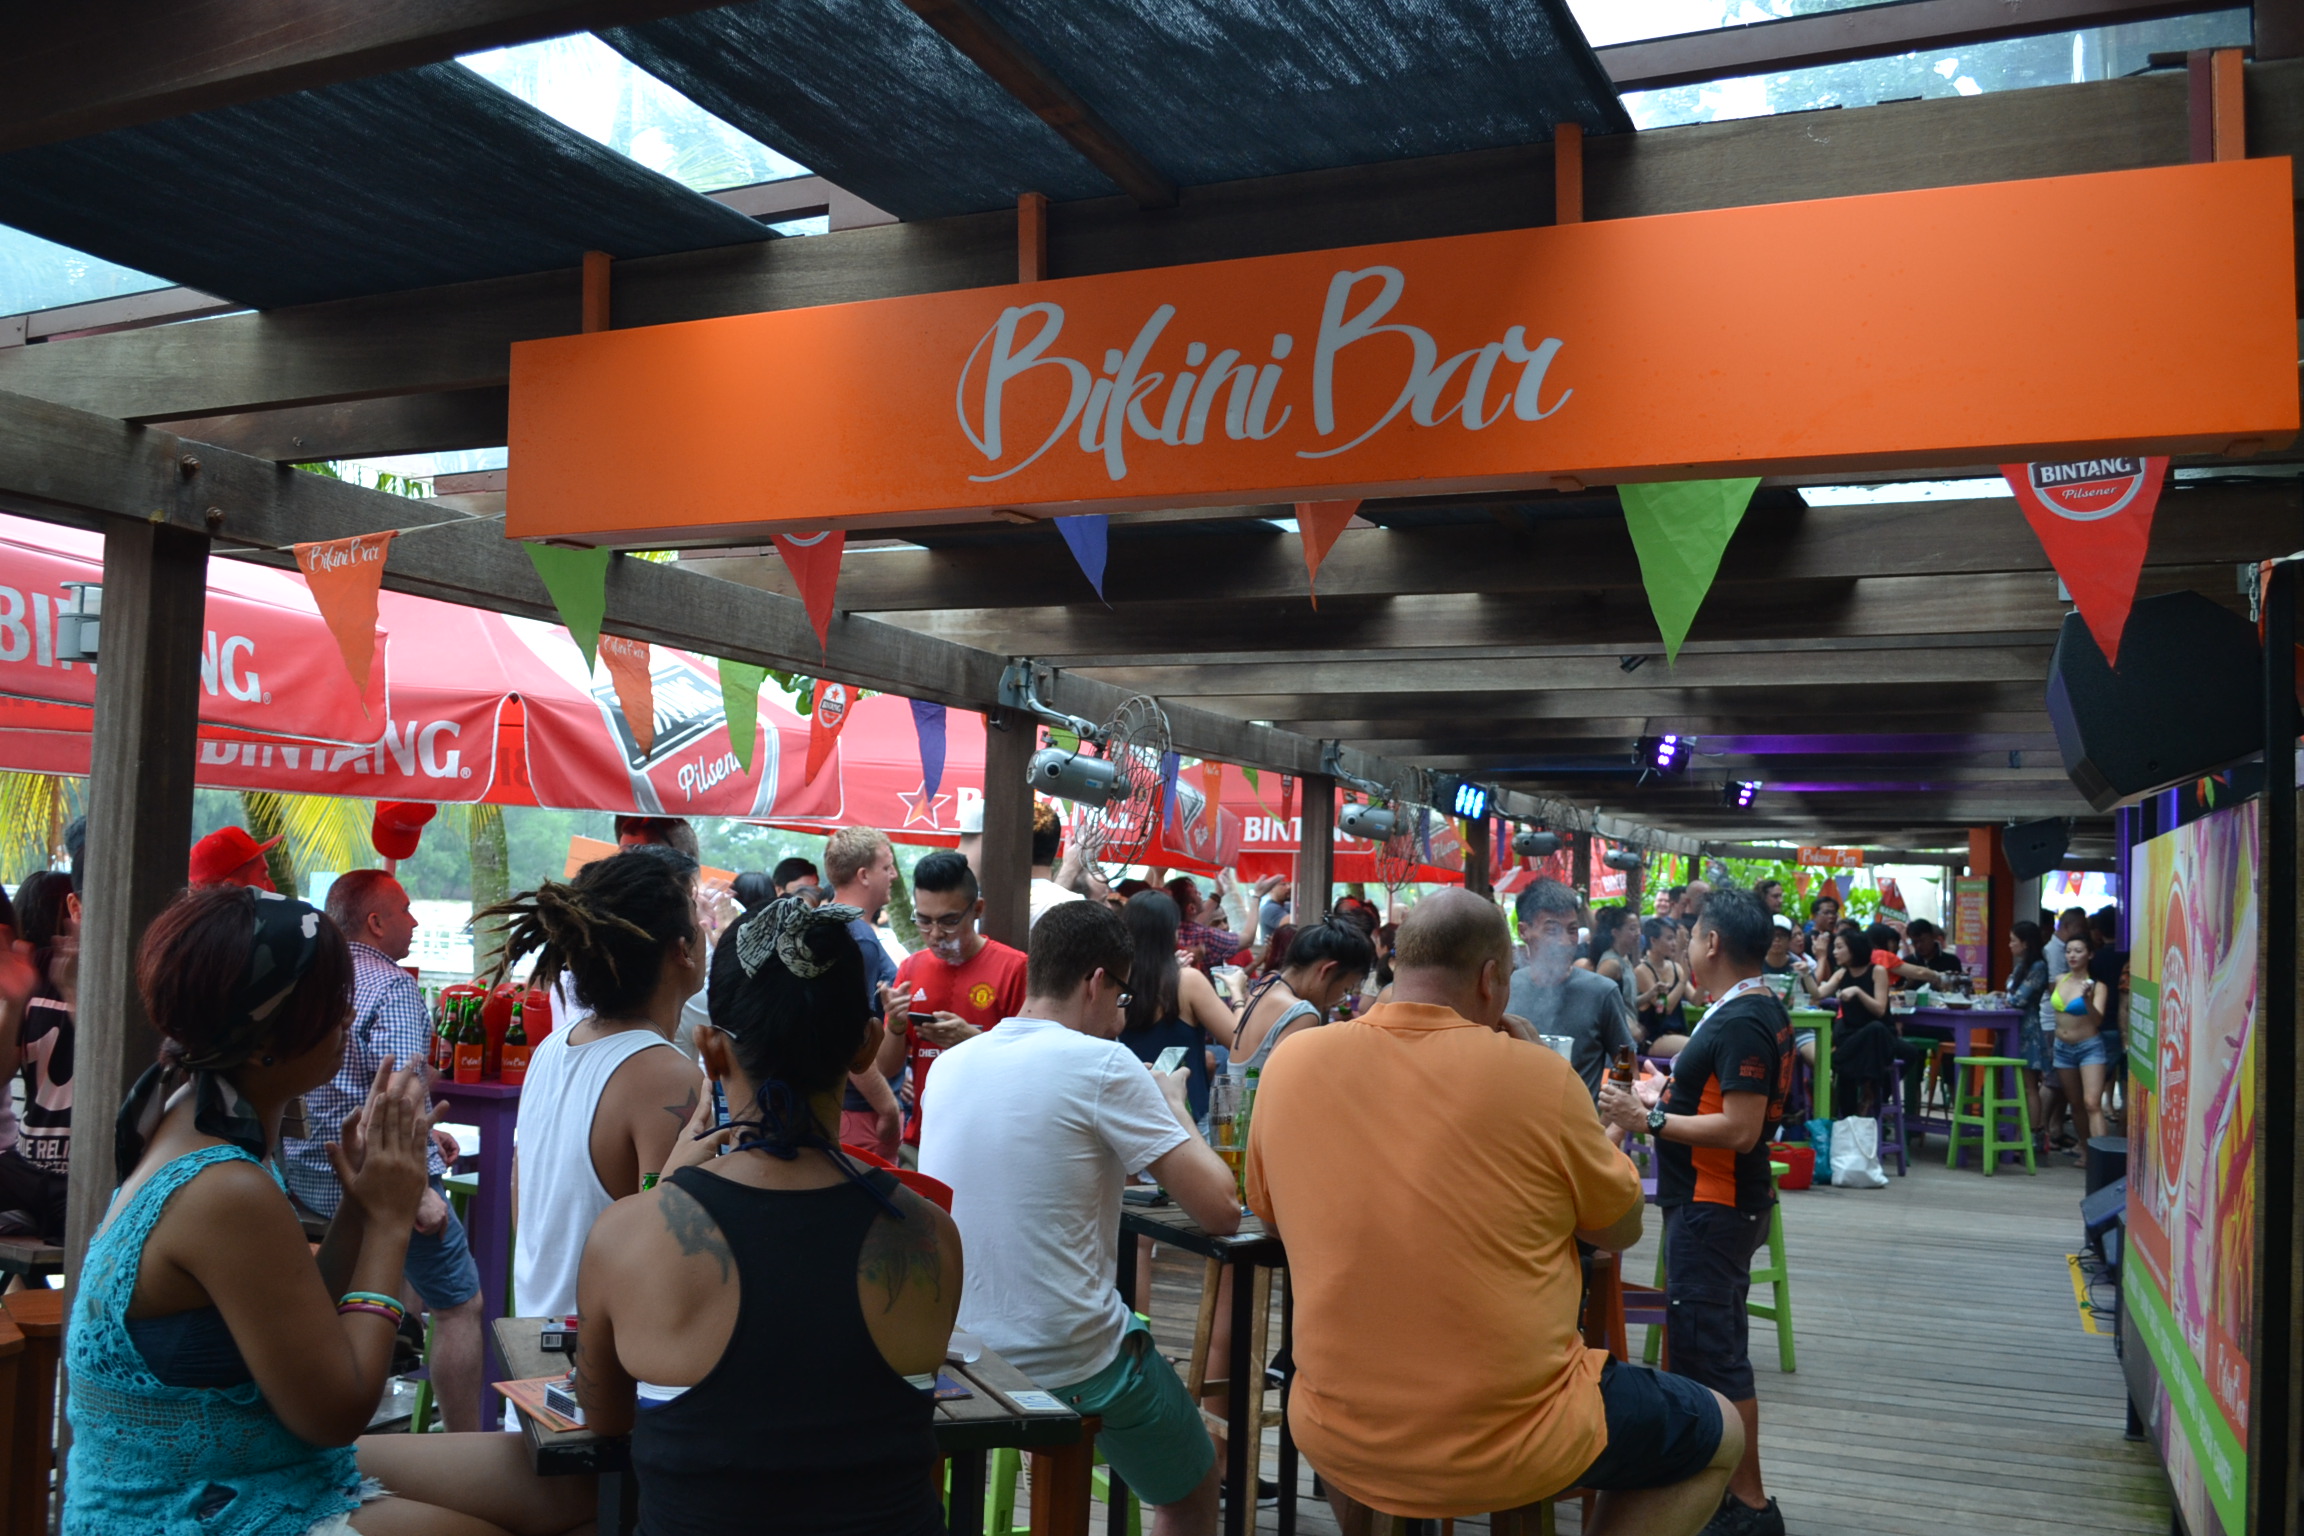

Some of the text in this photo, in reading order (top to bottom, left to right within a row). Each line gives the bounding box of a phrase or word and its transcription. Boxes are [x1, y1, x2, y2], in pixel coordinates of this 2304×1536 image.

[956, 265, 1574, 482] Bikini Bar
[2040, 457, 2131, 484] BINTANG
[2061, 486, 2118, 500] Pilsener
[306, 537, 379, 575] Bikini Bar
